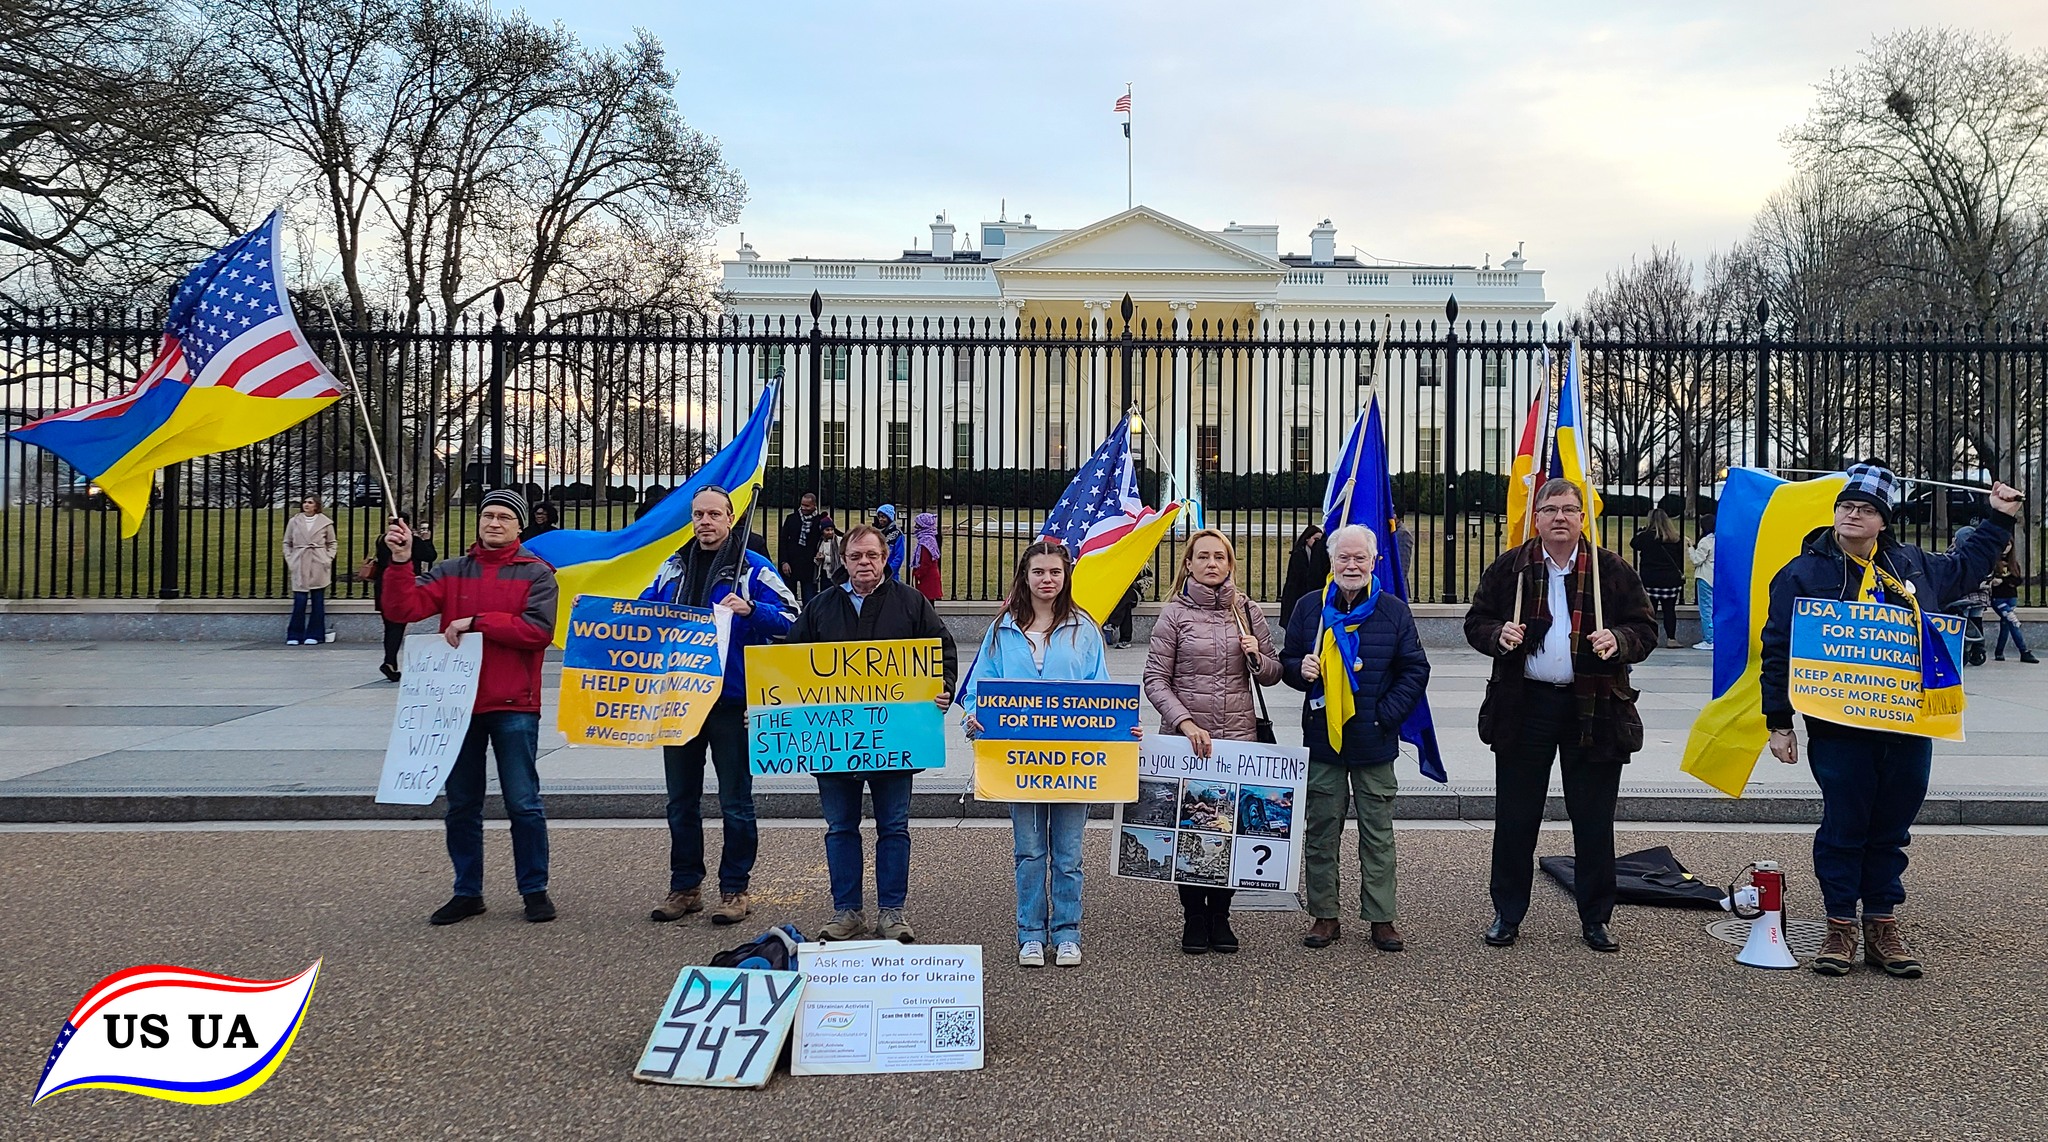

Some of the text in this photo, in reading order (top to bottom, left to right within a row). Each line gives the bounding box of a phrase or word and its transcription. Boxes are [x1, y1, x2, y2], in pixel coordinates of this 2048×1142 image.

[611, 602, 716, 625] #ArmUkraineN
[1797, 601, 1962, 635] USA, THANK OU
[573, 621, 652, 642] WOULD
[657, 627, 691, 643] YOU
[1822, 625, 1919, 647] FOR STANDIN
[608, 650, 712, 669] YOUR OME?
[810, 646, 943, 677] UKRAINE
[1823, 643, 1865, 659] WITH
[408, 652, 475, 677] What will they
[581, 674, 629, 693] HELP
[1794, 668, 1829, 681] KEEP
[1832, 672, 1897, 689] ARMING
[426, 680, 445, 702] they
[450, 684, 466, 694] can
[761, 683, 904, 705] IS WINNING
[1794, 684, 1845, 699] IMPOSE
[1848, 691, 1887, 703] MORE
[977, 696, 1138, 710] UKRAINE IS STANDING
[1844, 705, 1914, 723] ON RUSSIA
[398, 705, 468, 729] GET AWAY
[753, 707, 888, 728] THE WAR TO
[999, 715, 1116, 728] FOR THE WORLD
[409, 734, 450, 756] WITH
[757, 730, 885, 753] STABALIZE
[757, 751, 913, 774] WORLD ORDER
[1007, 751, 1106, 765] STAND FOR
[1150, 755, 1175, 774] you
[1216, 756, 1231, 773] the
[1238, 754, 1306, 781] PATTERN?
[394, 763, 439, 795] next?
[1016, 775, 1097, 789] UKRAINE
[815, 956, 964, 968] Ask me: What ordinary
[806, 971, 975, 985] people can do for Ukraine
[672, 969, 802, 1026] DAY
[641, 1021, 769, 1081] 347
